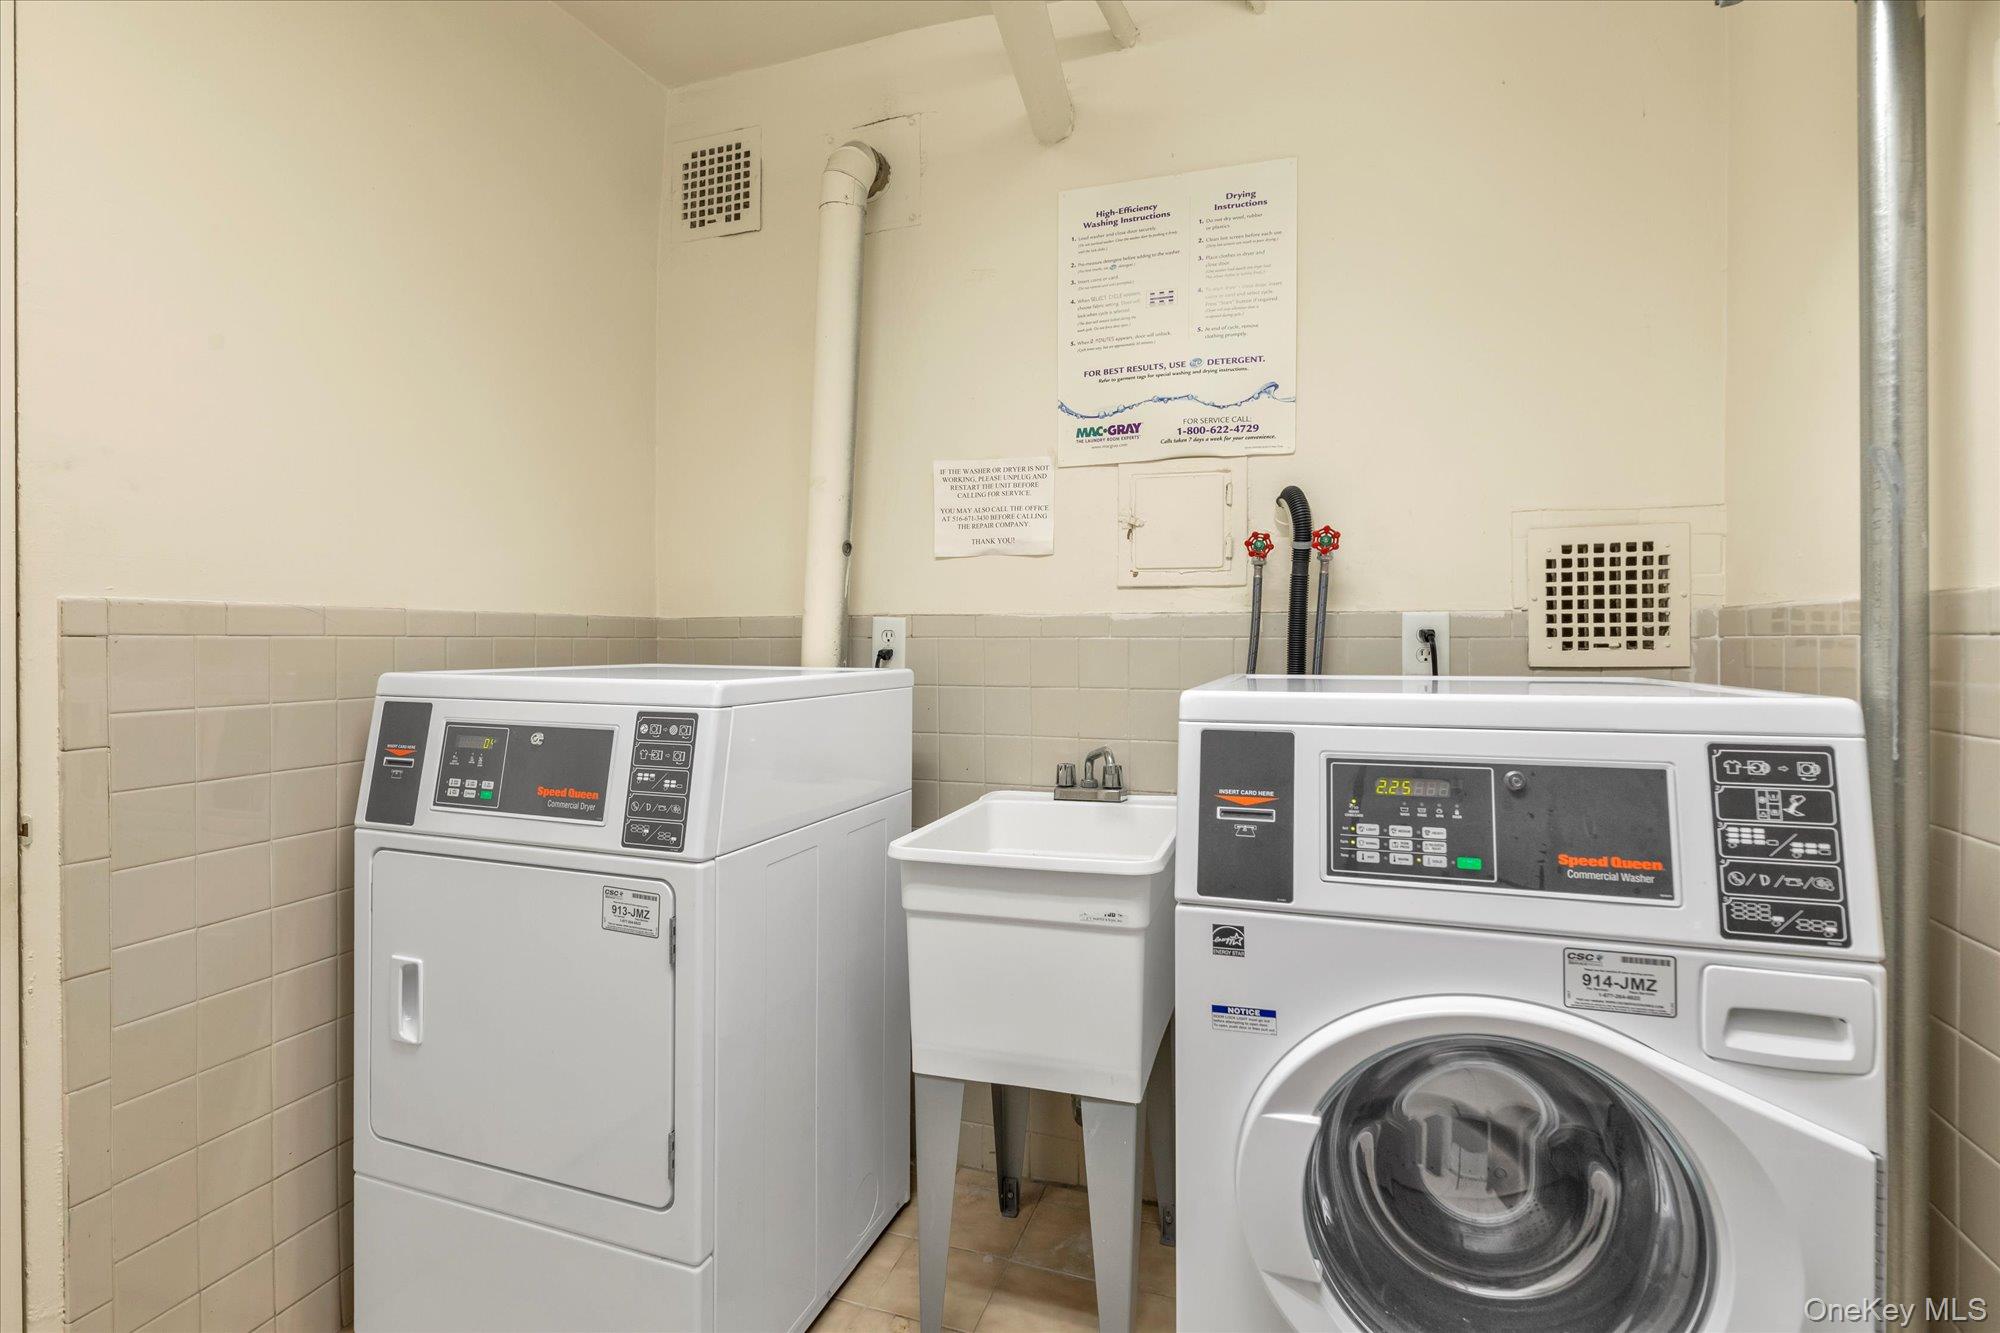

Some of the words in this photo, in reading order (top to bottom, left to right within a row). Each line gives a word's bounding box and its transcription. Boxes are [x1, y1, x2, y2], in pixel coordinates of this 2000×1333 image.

[1226, 191, 1256, 200] Drying
[1096, 204, 1158, 218] High-Efficiency
[1214, 199, 1267, 210] Instructions
[1083, 219, 1119, 229] Washing
[1121, 211, 1171, 223] Instructions
[1103, 367, 1125, 375] BEST
[1126, 363, 1167, 372] RESULTS,
[1169, 361, 1186, 369] USE
[1207, 356, 1265, 365] DETERGENT.
[1177, 424, 1259, 435] 1-800-622-4729
[537, 785, 567, 798] Speed
[568, 788, 598, 800] Queen
[1376, 779, 1411, 795] 2.25
[548, 800, 579, 809] Commercial
[581, 802, 595, 812] Dryer
[1558, 854, 1608, 868] Speed
[1611, 857, 1663, 870] Queen
[1567, 869, 1618, 881] Commercial
[1620, 874, 1655, 883] Washer
[612, 905, 650, 920] 913-JMZ
[1567, 952, 1595, 960] CSC
[1582, 973, 1657, 992] 914-JMZ
[1228, 1007, 1260, 1016] NOTICE
